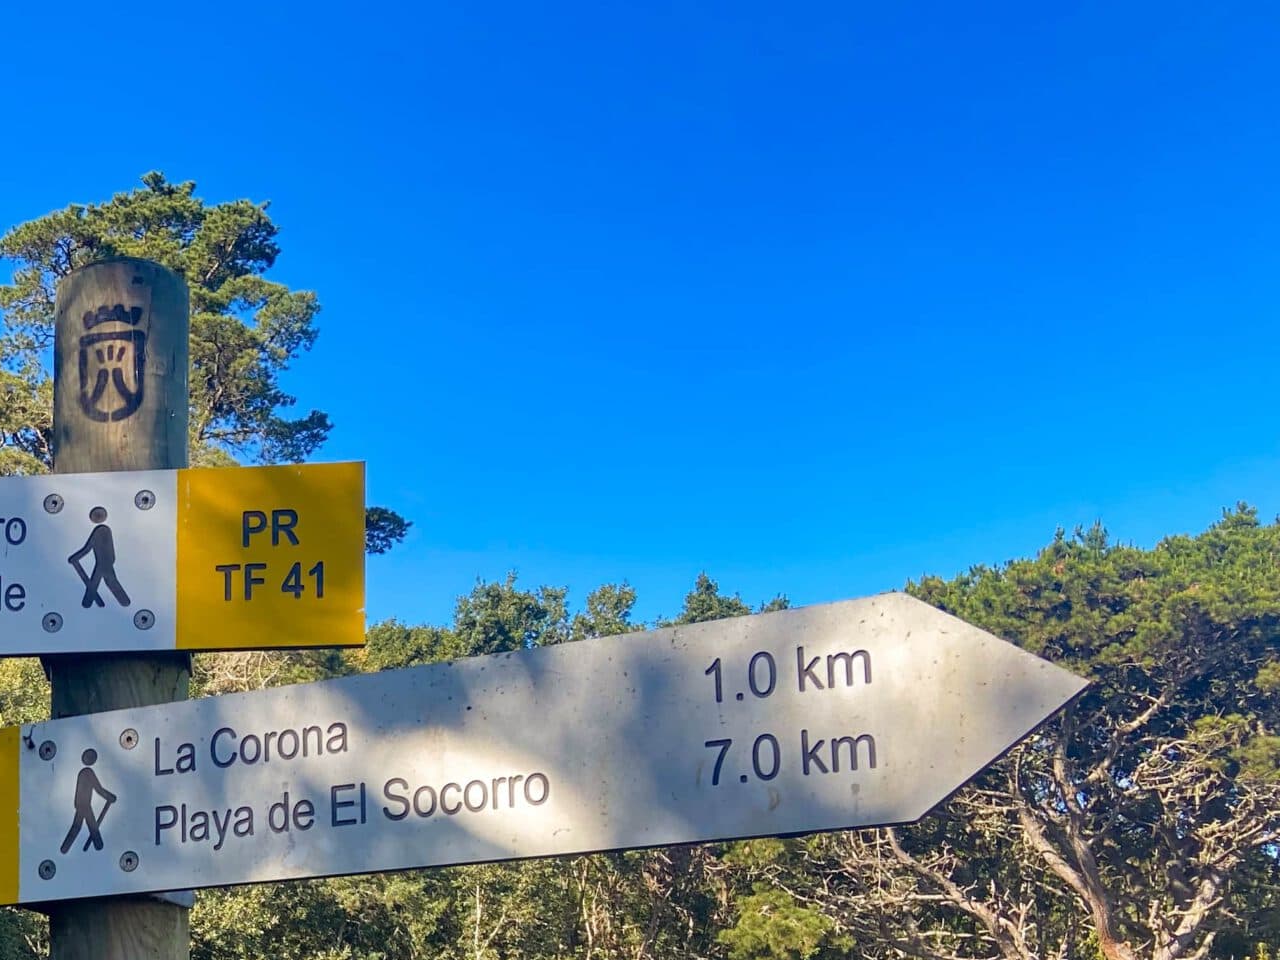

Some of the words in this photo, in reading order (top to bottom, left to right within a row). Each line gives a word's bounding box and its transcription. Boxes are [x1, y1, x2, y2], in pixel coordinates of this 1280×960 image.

[242, 508, 300, 548] PR
[215, 562, 267, 601] TF
[281, 560, 324, 599] 41
[704, 650, 777, 704] 1.0
[796, 645, 873, 693] km
[154, 736, 197, 777] La
[209, 722, 348, 769] Corona
[704, 733, 781, 786] 7.0
[800, 728, 877, 776] km
[154, 803, 255, 852] Playa
[268, 790, 316, 834] de
[330, 781, 367, 828] El
[382, 772, 550, 822] Socorro
